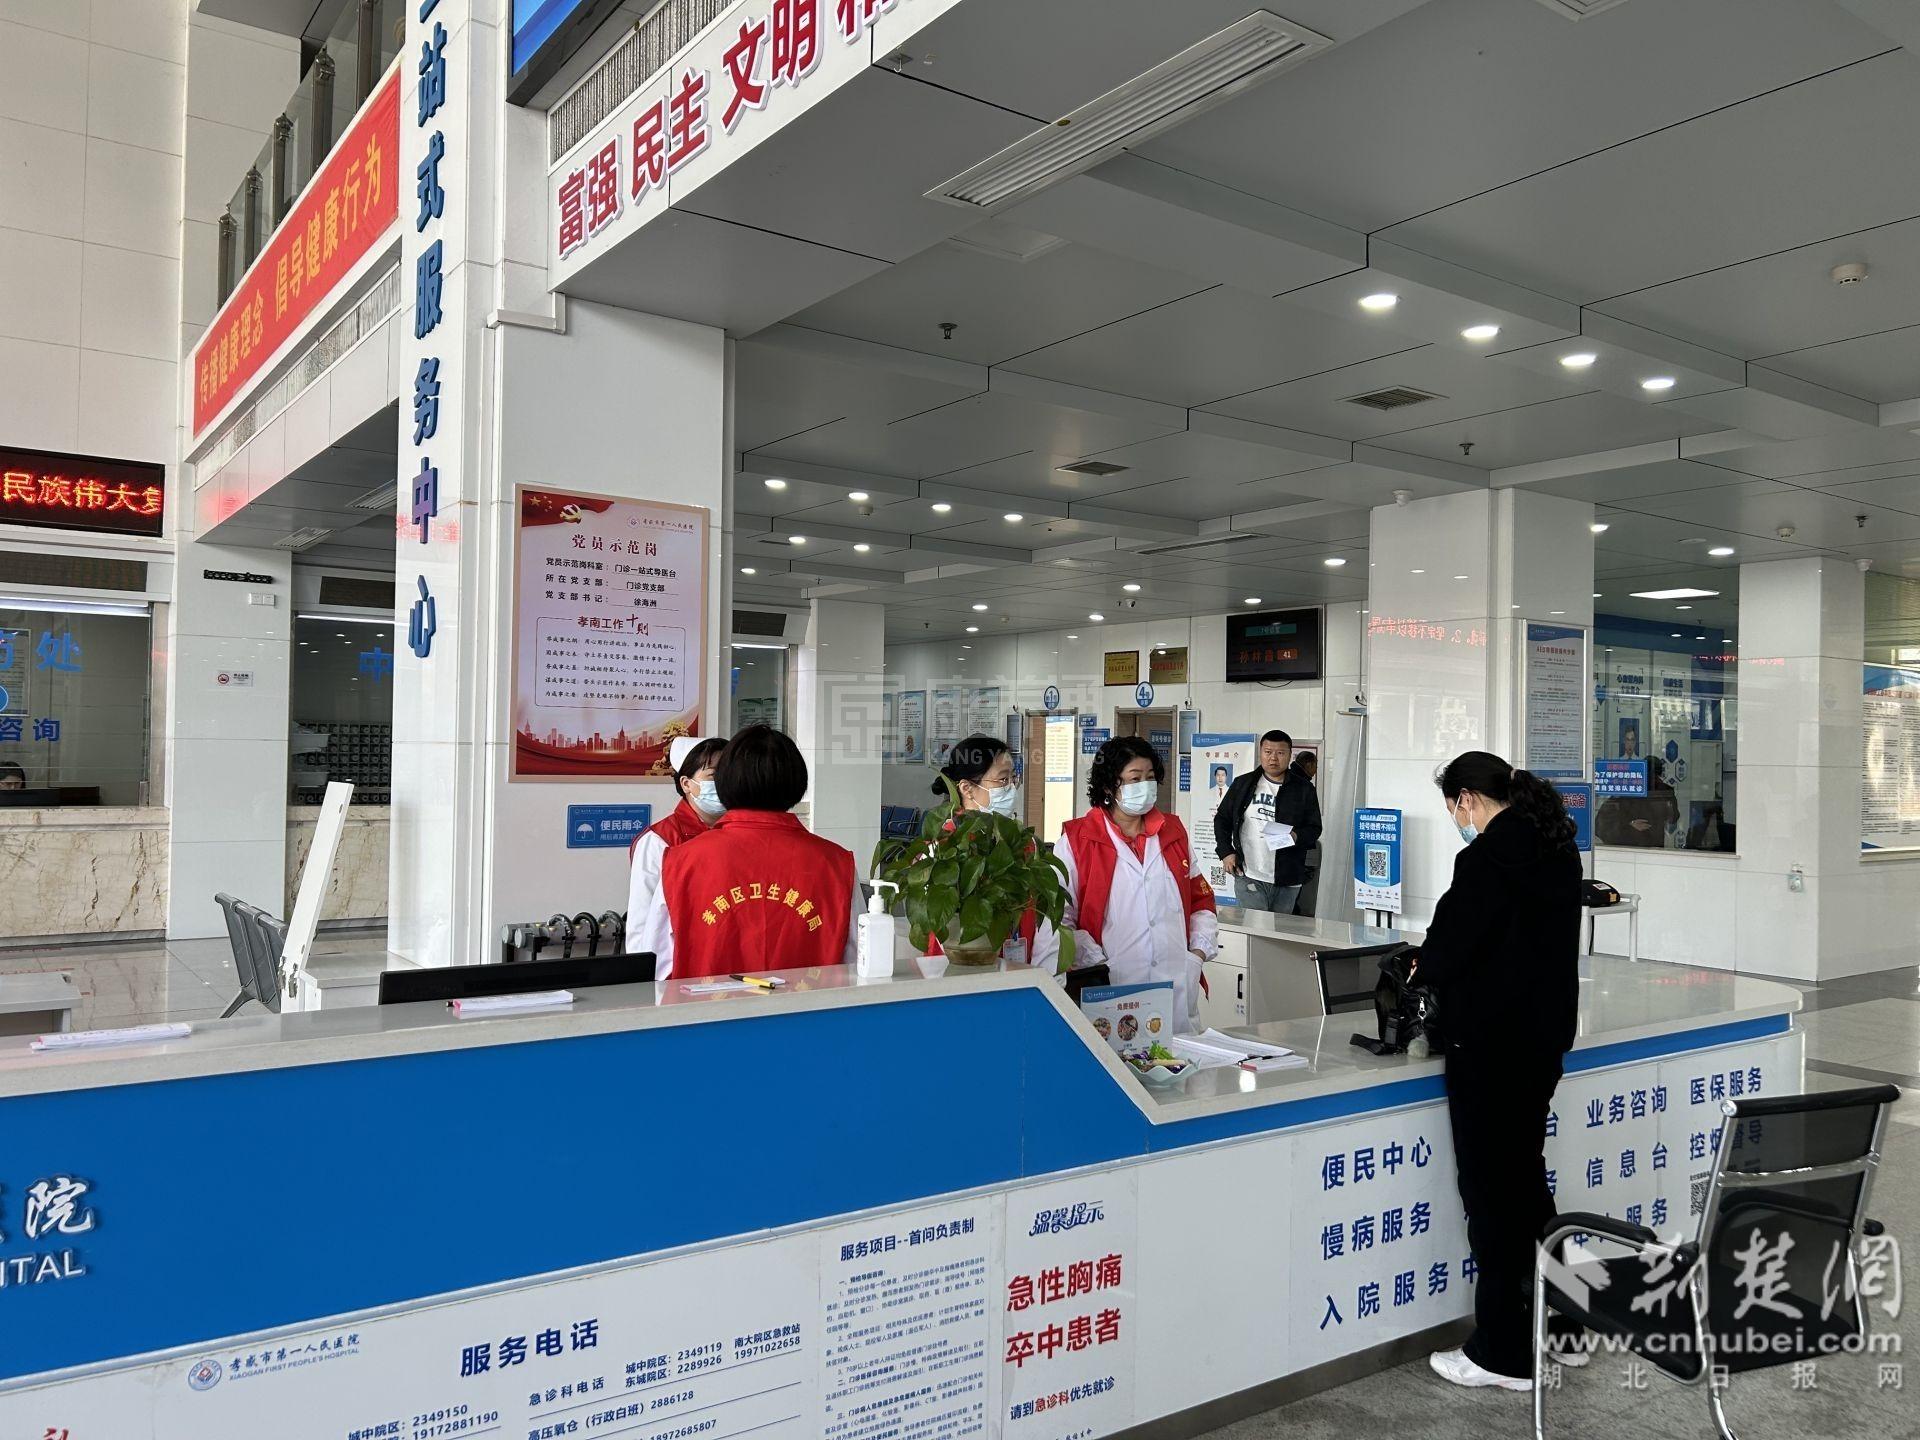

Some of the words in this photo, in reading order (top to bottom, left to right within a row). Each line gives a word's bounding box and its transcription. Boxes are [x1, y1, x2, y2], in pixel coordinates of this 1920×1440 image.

[558, 138, 620, 257] 富强
[631, 70, 707, 200] 民主
[721, 0, 818, 129] 文明
[199, 289, 263, 406] 传播健康理念
[275, 134, 382, 321] 倡导健康行为
[572, 534, 657, 557] 党员示范岗
[626, 581, 665, 593] 门诊党支部
[359, 646, 394, 683] 中
[600, 820, 643, 832] 便民雨伞
[701, 882, 823, 931] 孝南区卫生健康局
[1690, 1066, 1762, 1105] 医保服务
[1586, 1085, 1668, 1129] 业务咨询
[1321, 1135, 1432, 1192] 便民中心
[1586, 1142, 1668, 1189] 信息台
[0, 1177, 92, 1239] 院
[1028, 1200, 1105, 1237] 温馨提示
[840, 1216, 975, 1262] 服务项目--首问负责制
[1320, 1200, 1431, 1261] 慢病服务
[1006, 1253, 1123, 1312] 急性胸痛
[229, 1332, 361, 1371] 孝感市第一人民医院
[460, 1318, 600, 1378] 服务电话
[734, 1322, 801, 1348] 南大院区急救站
[734, 1336, 801, 1361] 19971022658
[1005, 1307, 1122, 1368] 卒中患者
[229, 1367, 264, 1381] XIAOGAN
[265, 1362, 287, 1374] FIRST
[287, 1355, 323, 1370] PEOPLE'S
[324, 1347, 360, 1361] HOSPITAL
[625, 1354, 672, 1375] 城中院区：
[677, 1341, 723, 1361] 2349119
[625, 1368, 672, 1389] 东城院区：
[677, 1354, 723, 1375] 2289926
[528, 1376, 605, 1407] 急诊科电话
[650, 1390, 694, 1410] 2886128
[1010, 1375, 1115, 1420] 请到急诊科优先就诊
[412, 1404, 469, 1427] 2349150
[412, 1411, 499, 1440] 19172881190
